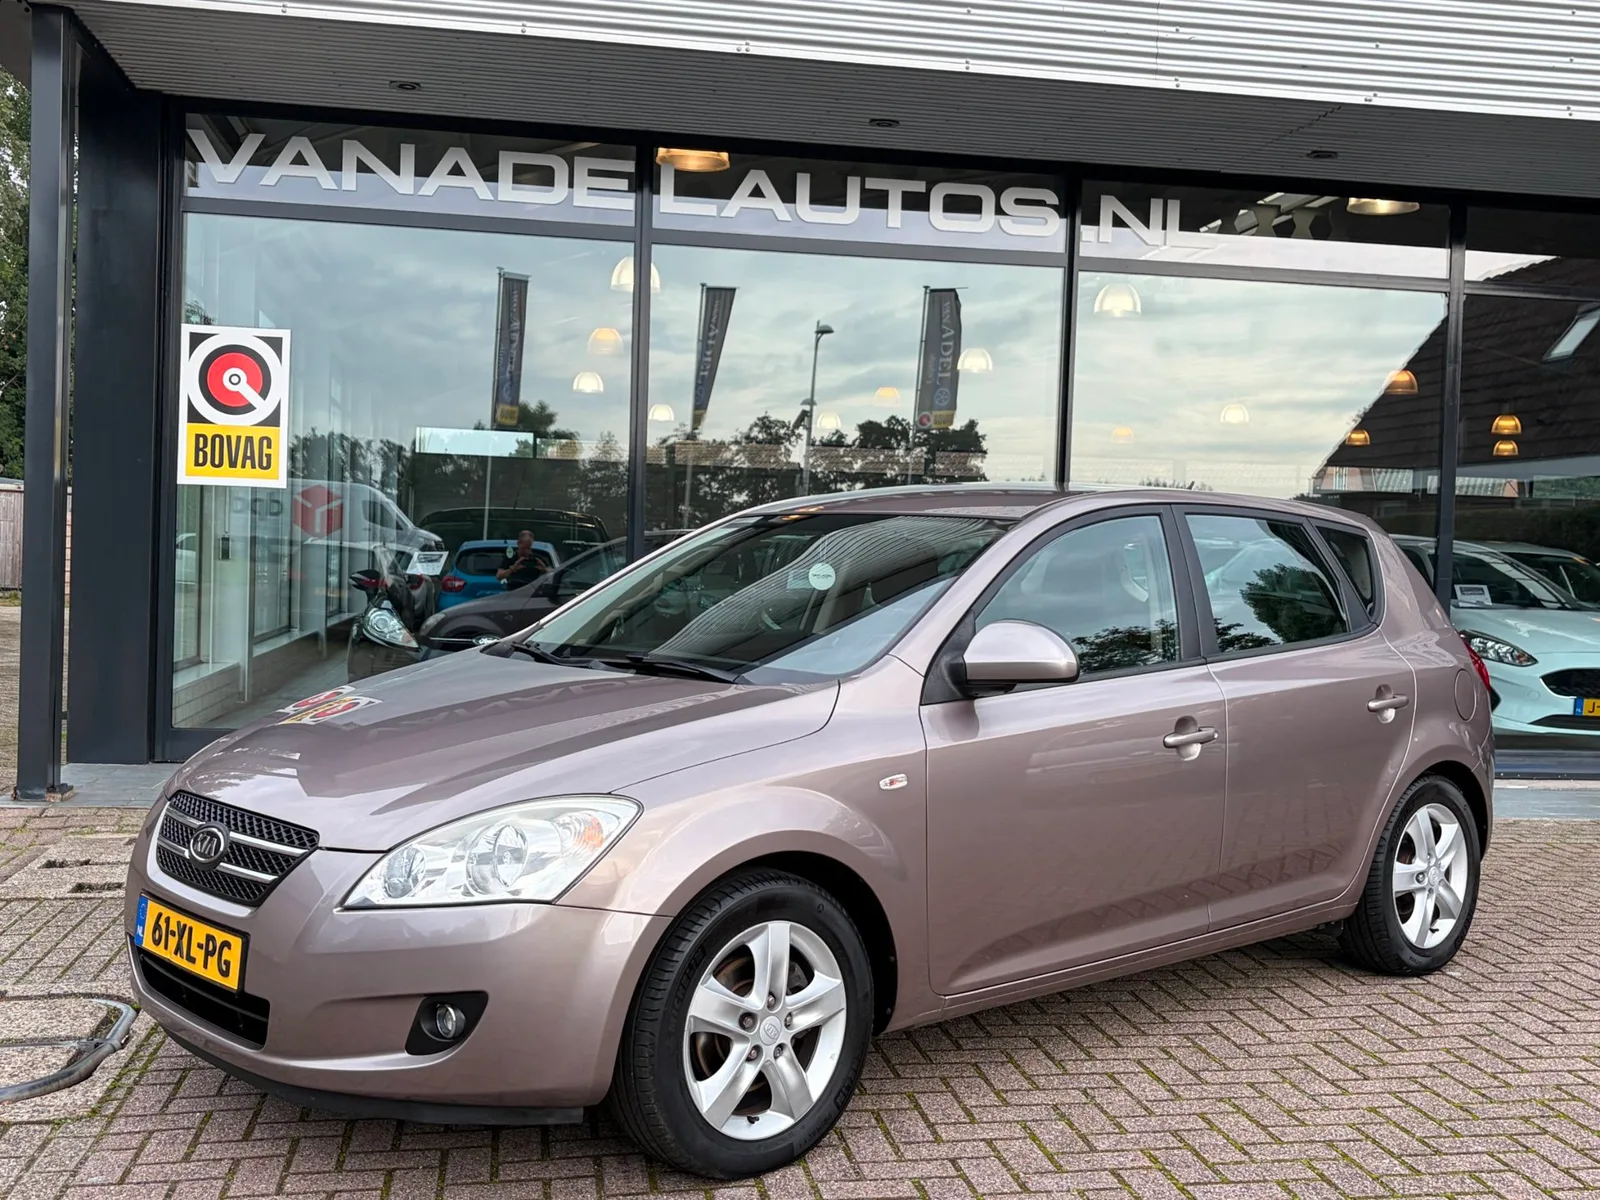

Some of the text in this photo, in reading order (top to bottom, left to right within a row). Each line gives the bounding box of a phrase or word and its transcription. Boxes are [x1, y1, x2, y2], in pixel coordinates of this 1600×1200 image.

[937, 325, 955, 386] ADEL
[194, 433, 272, 471] BOVAG
[136, 924, 144, 938] NL
[151, 911, 232, 978] 61-XL-PG
